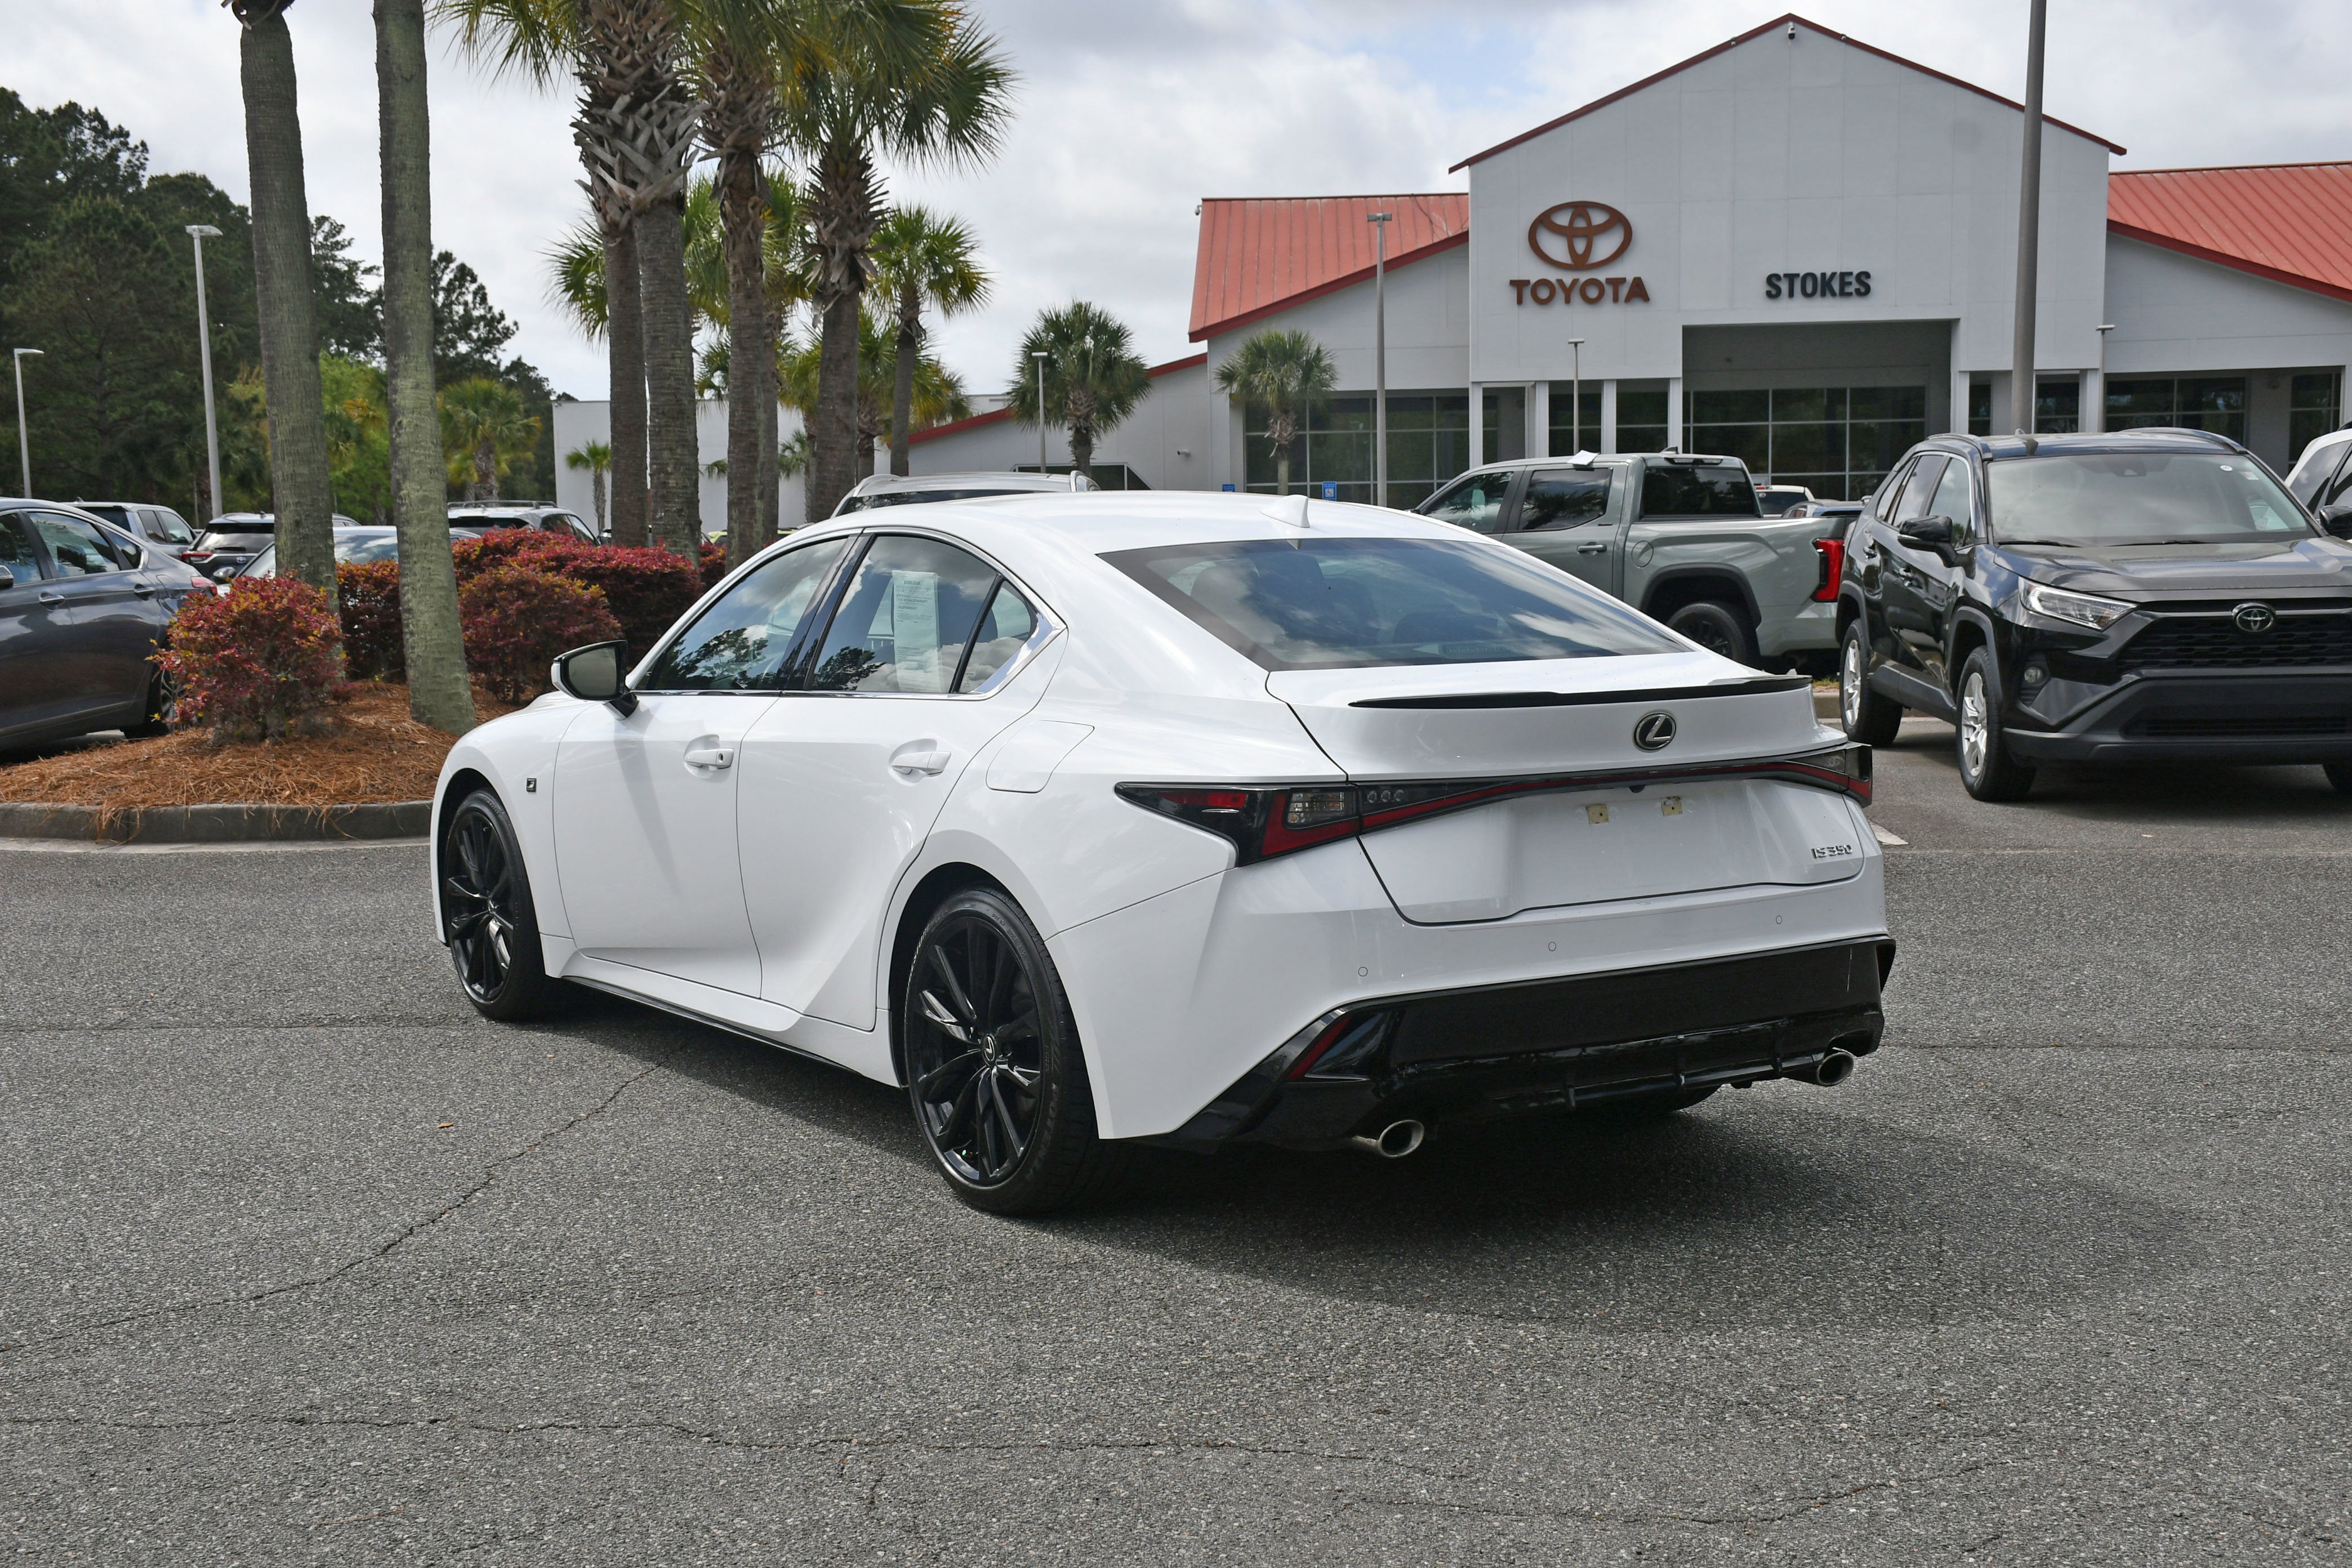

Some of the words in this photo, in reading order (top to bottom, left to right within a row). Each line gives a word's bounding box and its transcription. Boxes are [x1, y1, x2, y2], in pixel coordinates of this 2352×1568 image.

[1509, 277, 1650, 305] TOYOTA
[1765, 271, 1872, 299] STOKES
[1826, 844, 1853, 857] 350
